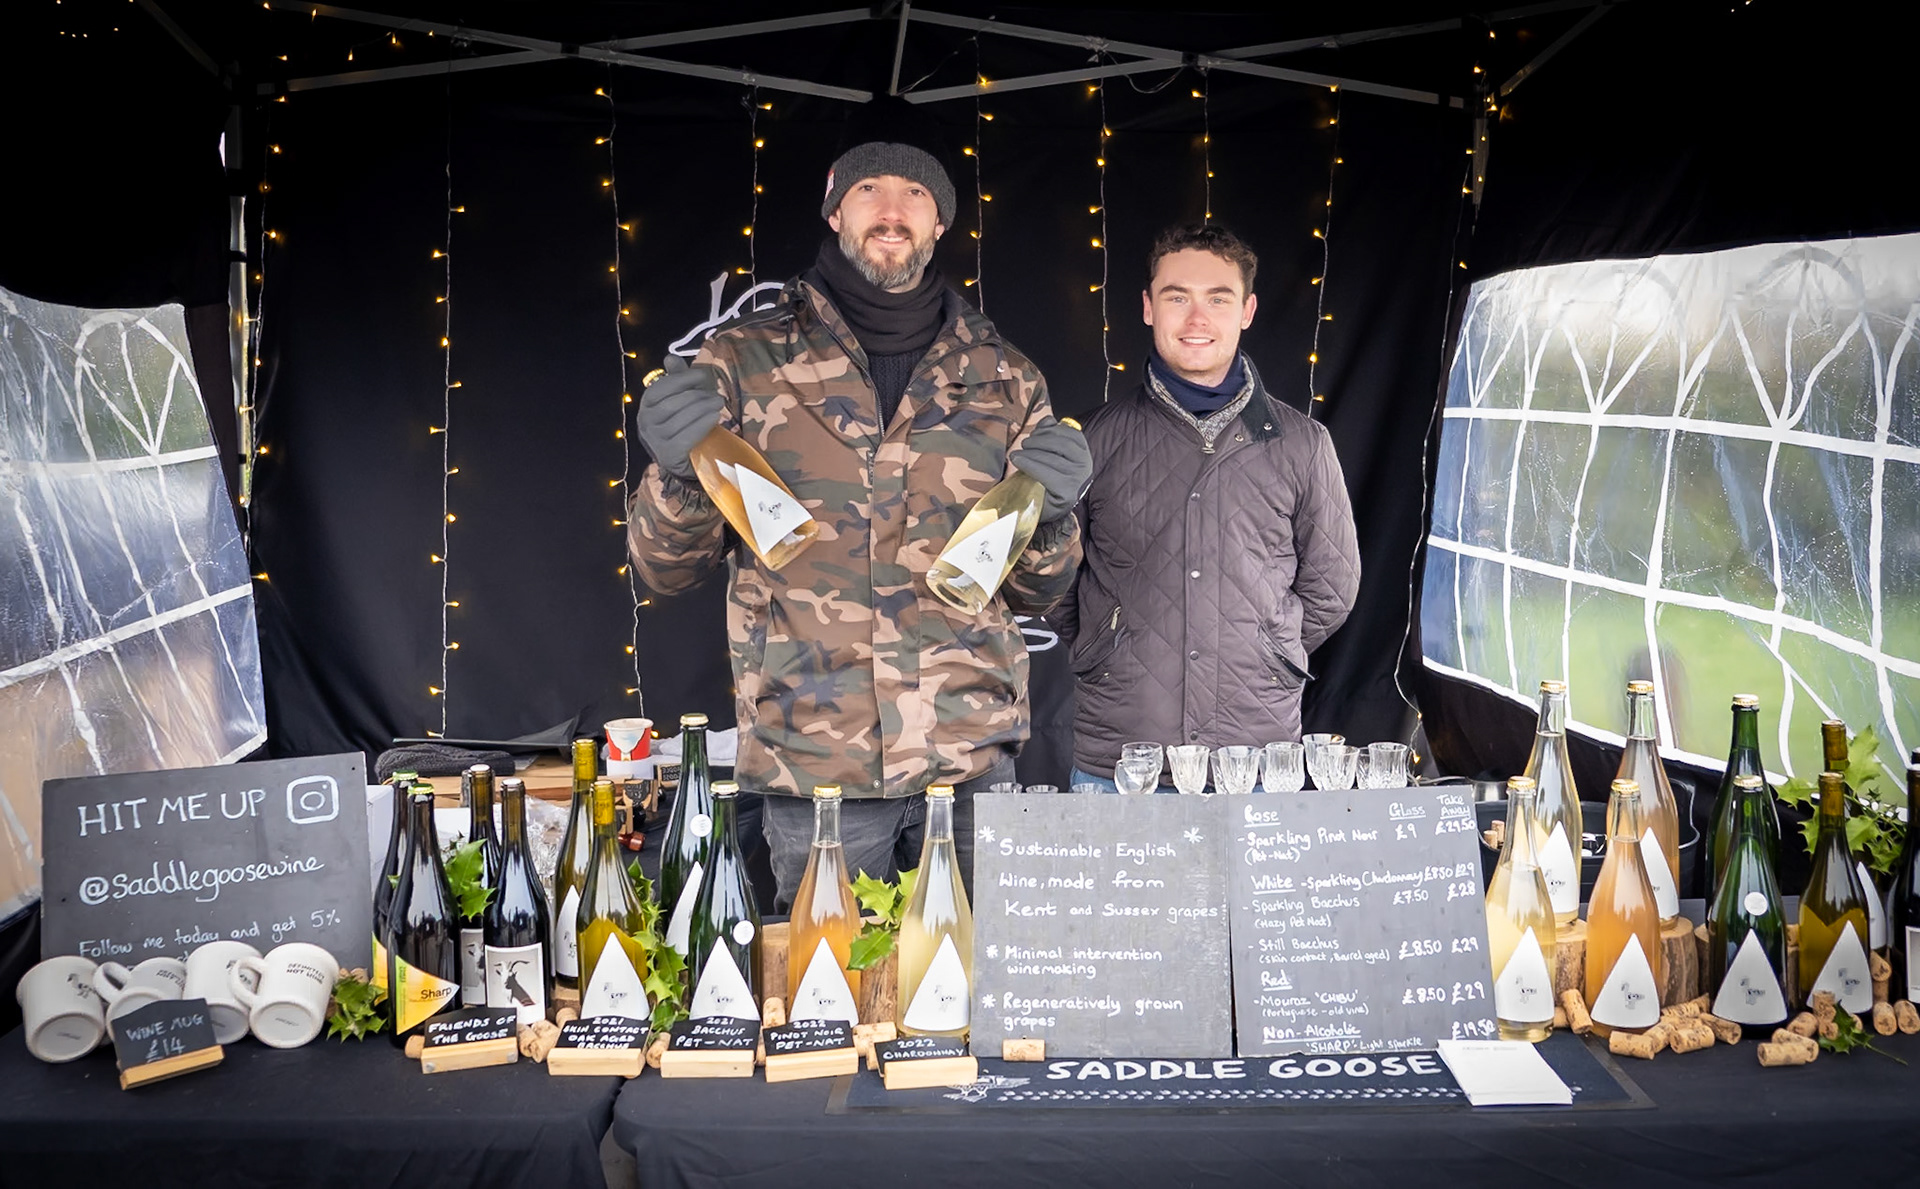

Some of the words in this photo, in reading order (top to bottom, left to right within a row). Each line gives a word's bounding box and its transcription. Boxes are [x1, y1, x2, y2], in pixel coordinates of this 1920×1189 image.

[1436, 794, 1464, 805] Take
[77, 798, 147, 837] HIT
[157, 792, 210, 825] ME
[220, 788, 266, 819] UP
[1244, 804, 1279, 824] Rose
[1389, 802, 1426, 818] Glass
[1441, 805, 1471, 819] Away
[1317, 827, 1347, 844] Pinot
[1352, 828, 1378, 841] Noir
[1000, 838, 1101, 858] Sustainable
[1115, 842, 1177, 865] English
[1049, 872, 1095, 889] made
[1112, 870, 1165, 889] from
[1250, 873, 1294, 890] White
[1310, 893, 1361, 909] Bacchus
[1393, 889, 1429, 906] £7.50
[1447, 880, 1476, 902] £28
[1005, 899, 1057, 917] Kent
[1069, 904, 1093, 916] and
[1102, 903, 1160, 917] Sussex
[1167, 906, 1219, 924] grapes
[79, 938, 133, 958] Follow
[143, 938, 165, 949] me
[174, 925, 220, 945] today
[230, 921, 261, 941] and
[272, 918, 296, 943] get
[311, 908, 341, 928] 5%
[1254, 918, 1286, 934] (Hazy
[1005, 944, 1062, 961] Minimal
[1073, 947, 1162, 962] intervention
[1259, 937, 1286, 951] Still
[1291, 935, 1340, 949] Bacchus
[1399, 940, 1442, 960] £8.50
[1451, 936, 1479, 953] £29
[1290, 951, 1327, 963] contact
[1007, 961, 1097, 979] winemaking
[1260, 969, 1290, 986] Red
[421, 987, 452, 1000] Sharp
[1402, 987, 1446, 1005] £8.50
[1451, 981, 1485, 1005] £29
[1003, 992, 1122, 1017] Regeneratively
[1135, 998, 1184, 1016] grown
[126, 1021, 167, 1041] WINE
[170, 1013, 204, 1031] MUG
[428, 1017, 490, 1033] FRIENDS
[496, 1015, 516, 1026] OF
[592, 1016, 625, 1026] 2021
[705, 1016, 734, 1025] 2021
[793, 1019, 826, 1029] 2022
[1004, 1016, 1056, 1032] grapes
[1451, 1018, 1496, 1040] £19.50
[563, 1025, 590, 1034] SKIN
[593, 1026, 649, 1035] CONTACT
[567, 1034, 597, 1042] OAK
[600, 1034, 635, 1042] AGED
[691, 1025, 746, 1036] BACCHUS
[770, 1031, 808, 1041] PINOT
[814, 1027, 844, 1037] NOIR
[432, 1033, 459, 1045] THE
[897, 1038, 936, 1049] 2022
[1360, 1038, 1384, 1052] Light
[145, 1037, 187, 1063] £14
[1046, 1059, 1246, 1081] SADDLE
[1268, 1054, 1443, 1079] GOOSE
